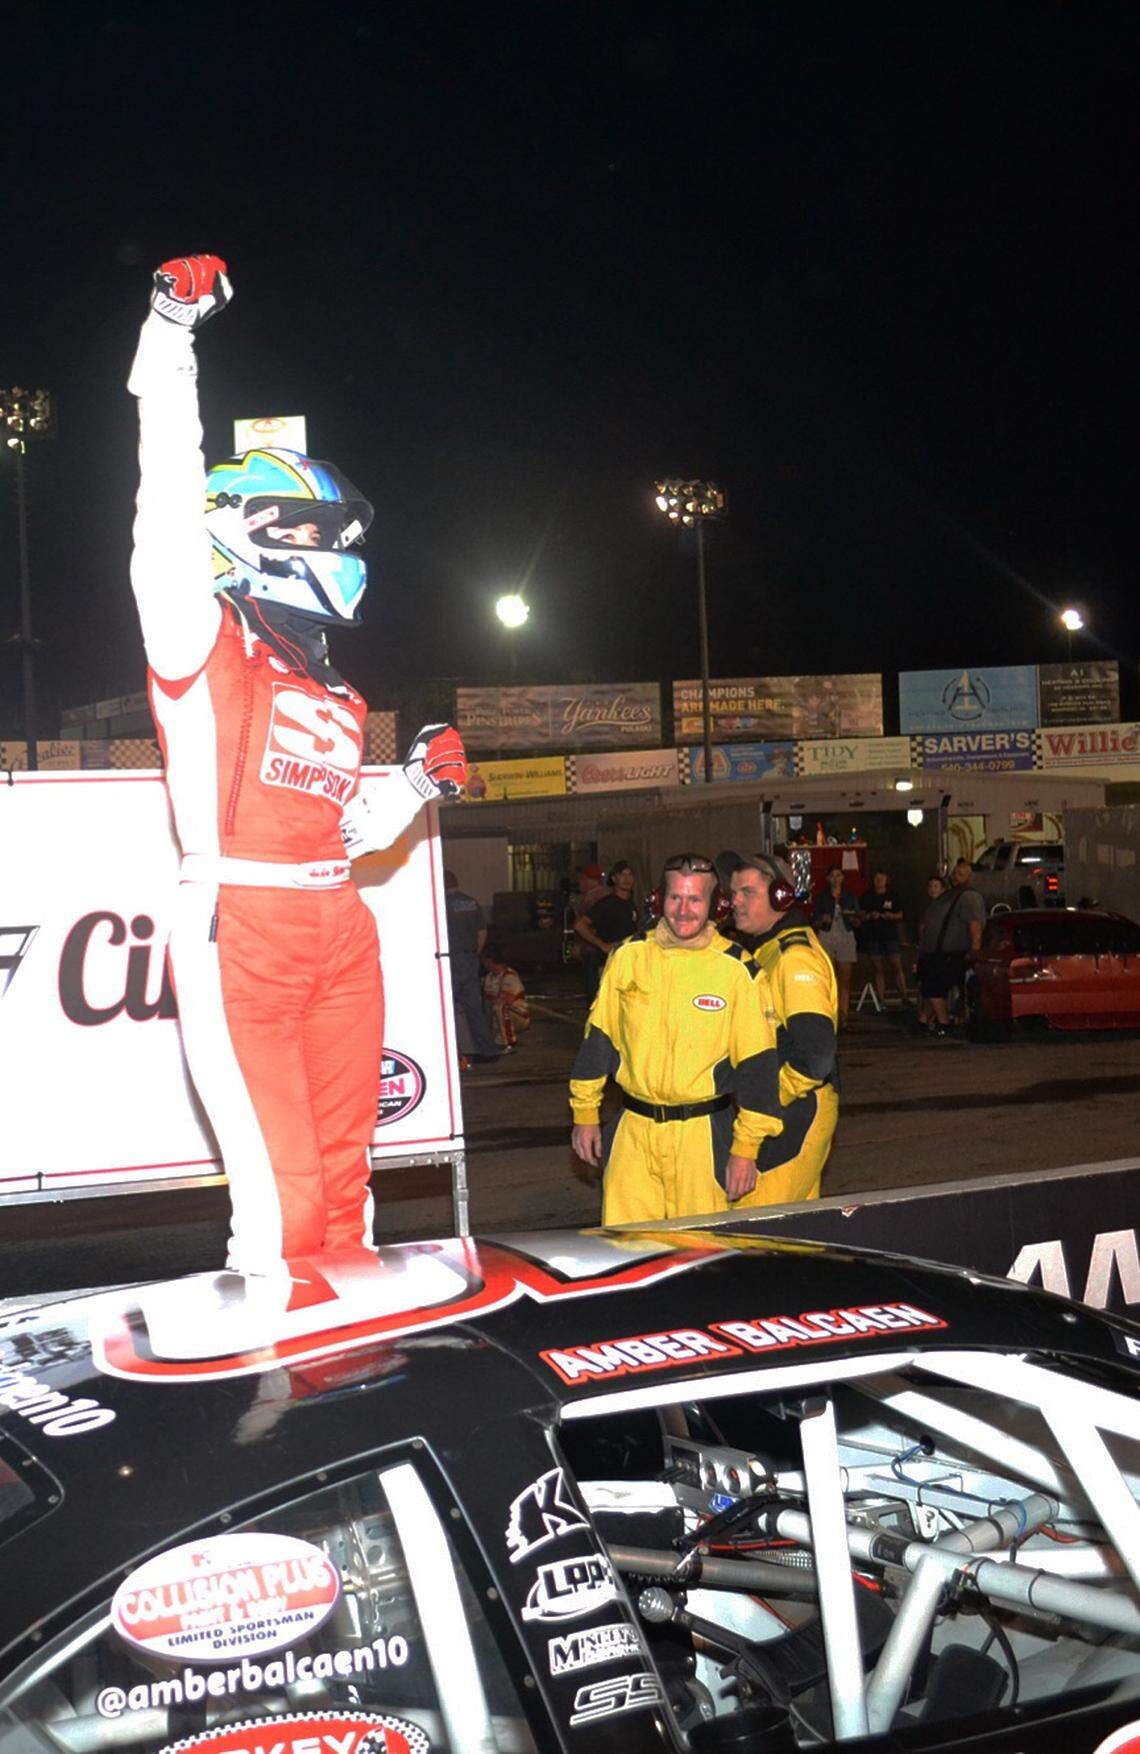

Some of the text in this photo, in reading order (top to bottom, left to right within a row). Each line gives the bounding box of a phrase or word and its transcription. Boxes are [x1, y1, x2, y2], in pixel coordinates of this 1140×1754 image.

[559, 694, 651, 735] Yankees
[709, 701, 745, 714] MADE
[924, 732, 1030, 755] SARVER'S
[624, 764, 673, 780] LIGHT
[697, 998, 721, 1008] BELL
[546, 1303, 941, 1382] AMBER BALCAEN
[117, 1566, 264, 1625] COLLISION
[260, 1555, 333, 1599] PLUS
[167, 1627, 224, 1648] LIMITED
[230, 1611, 316, 1636] SPORTSMAN
[212, 1629, 278, 1650] DIVISION
[95, 1634, 410, 1720] @amberbalcaen10
